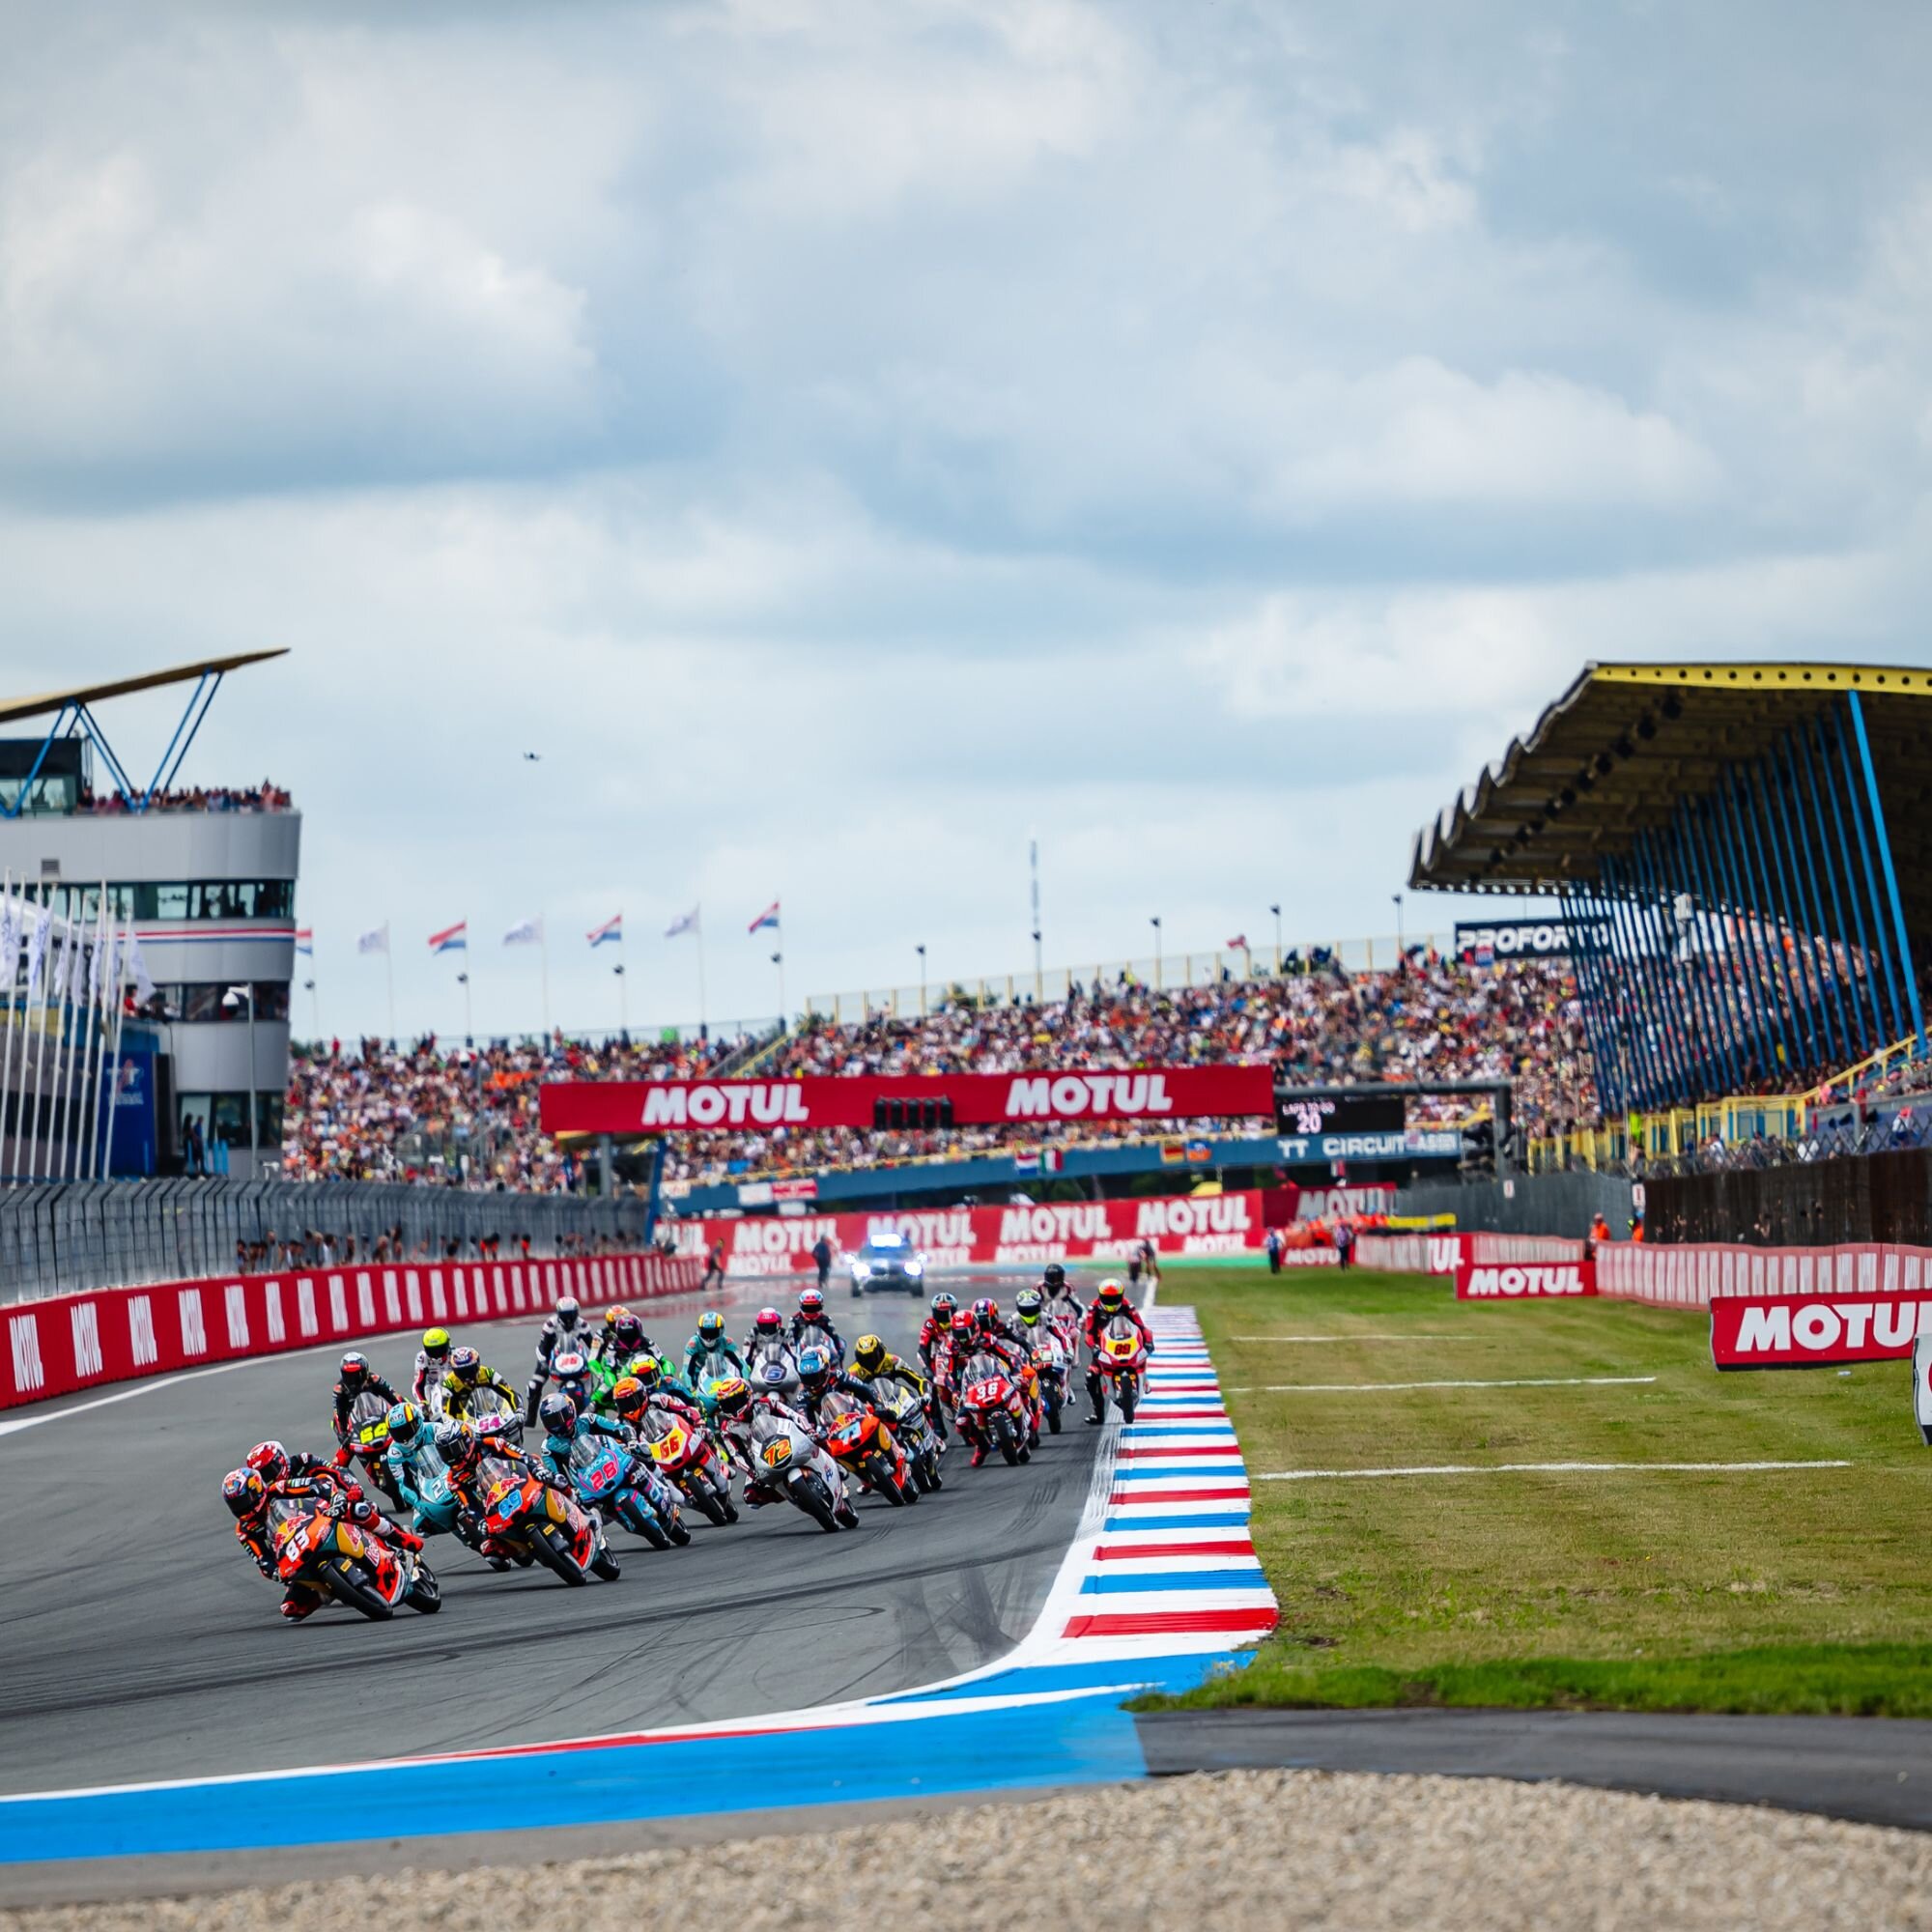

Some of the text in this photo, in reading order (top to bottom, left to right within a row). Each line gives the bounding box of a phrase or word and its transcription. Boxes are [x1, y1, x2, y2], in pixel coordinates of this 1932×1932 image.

[641, 1084, 810, 1125] MOTUL
[1005, 1074, 1174, 1117] MOTUL
[1296, 1112, 1322, 1134] 20
[1278, 1139, 1310, 1158] TT
[1322, 1134, 1406, 1157] CIRCUIT
[1000, 1205, 1112, 1244] MOTUL
[1136, 1195, 1251, 1236] MOTUL
[1182, 1233, 1245, 1254] MOTUL
[1285, 1247, 1341, 1264] MOTU
[1467, 1266, 1584, 1295] MOTUL
[976, 1381, 999, 1400] 36
[359, 1422, 388, 1445] 64
[478, 1415, 503, 1433] 54
[763, 1438, 792, 1468] 72
[589, 1461, 618, 1492] 28
[286, 1526, 310, 1563] 83
